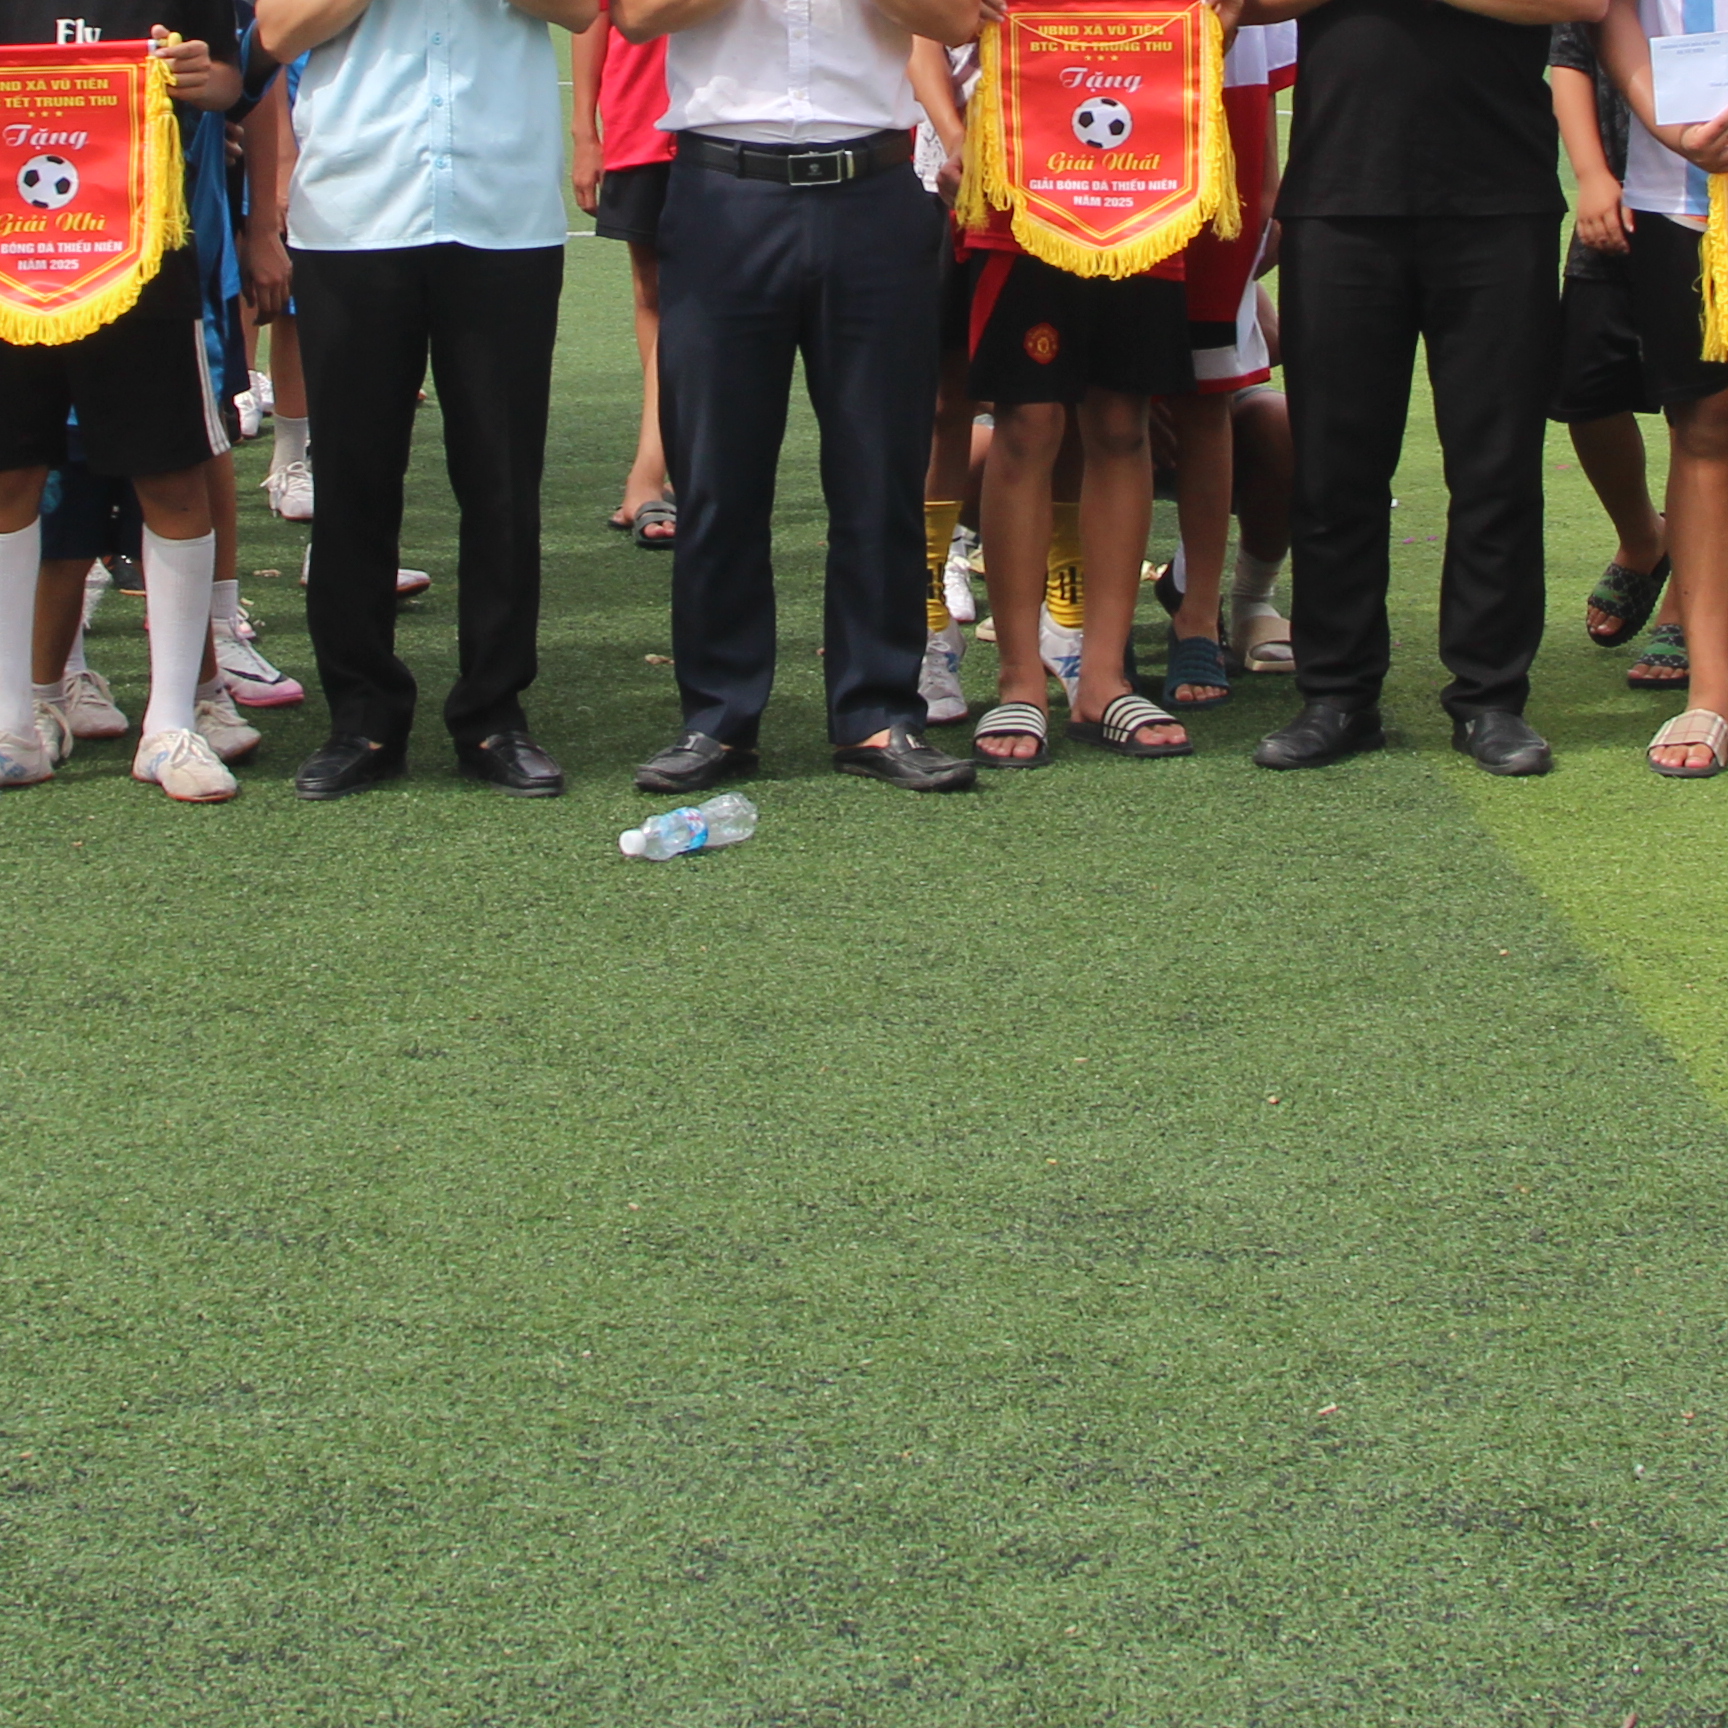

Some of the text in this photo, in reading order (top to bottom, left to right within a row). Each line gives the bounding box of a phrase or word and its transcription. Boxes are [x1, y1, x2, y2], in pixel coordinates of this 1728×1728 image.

[1038, 25, 1079, 35] UBND
[1030, 42, 1058, 51] BTC
[1093, 42, 1140, 51] TRUNG
[1144, 42, 1172, 51] THU
[1059, 67, 1144, 93] Tặng
[35, 96, 85, 107] TRUNG
[89, 96, 118, 106] THU
[2, 124, 88, 150] Tặng
[1104, 197, 1134, 207] 2025
[50, 259, 79, 270] 2025
